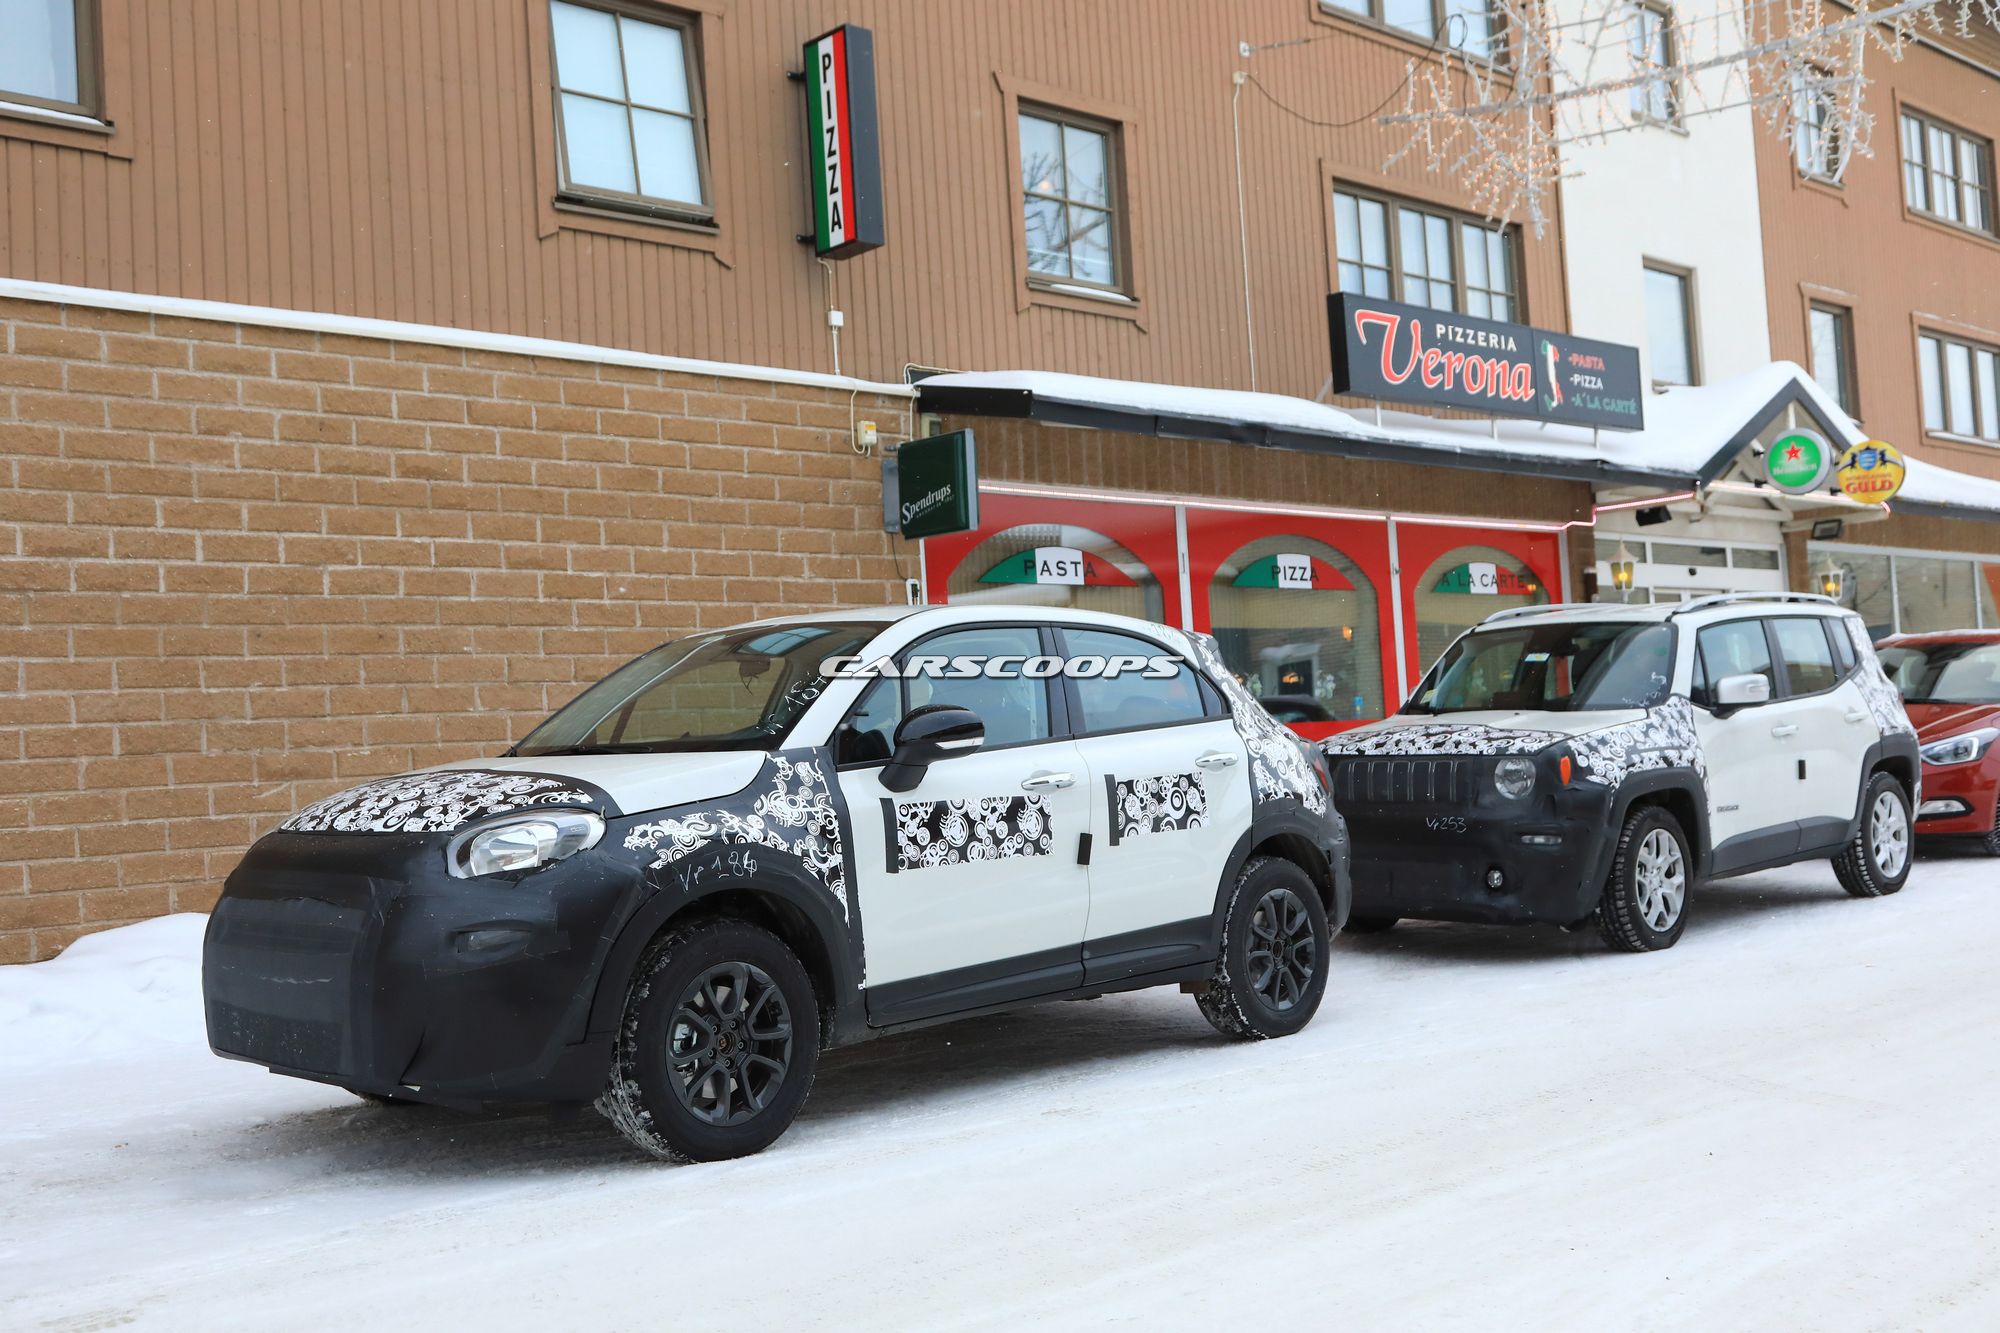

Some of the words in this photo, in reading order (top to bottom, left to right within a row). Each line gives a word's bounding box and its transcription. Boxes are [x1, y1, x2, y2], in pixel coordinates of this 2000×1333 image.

[822, 53, 842, 233] PIZZA
[1436, 323, 1517, 352] PIZZERIA
[1354, 309, 1536, 402] Verona
[1845, 479, 1894, 493] GULD
[902, 483, 952, 525] Spendrups
[1024, 559, 1097, 577] PASTA
[1271, 564, 1320, 582] PIZZA
[1458, 573, 1476, 587] LA
[1480, 573, 1526, 589] CARTE
